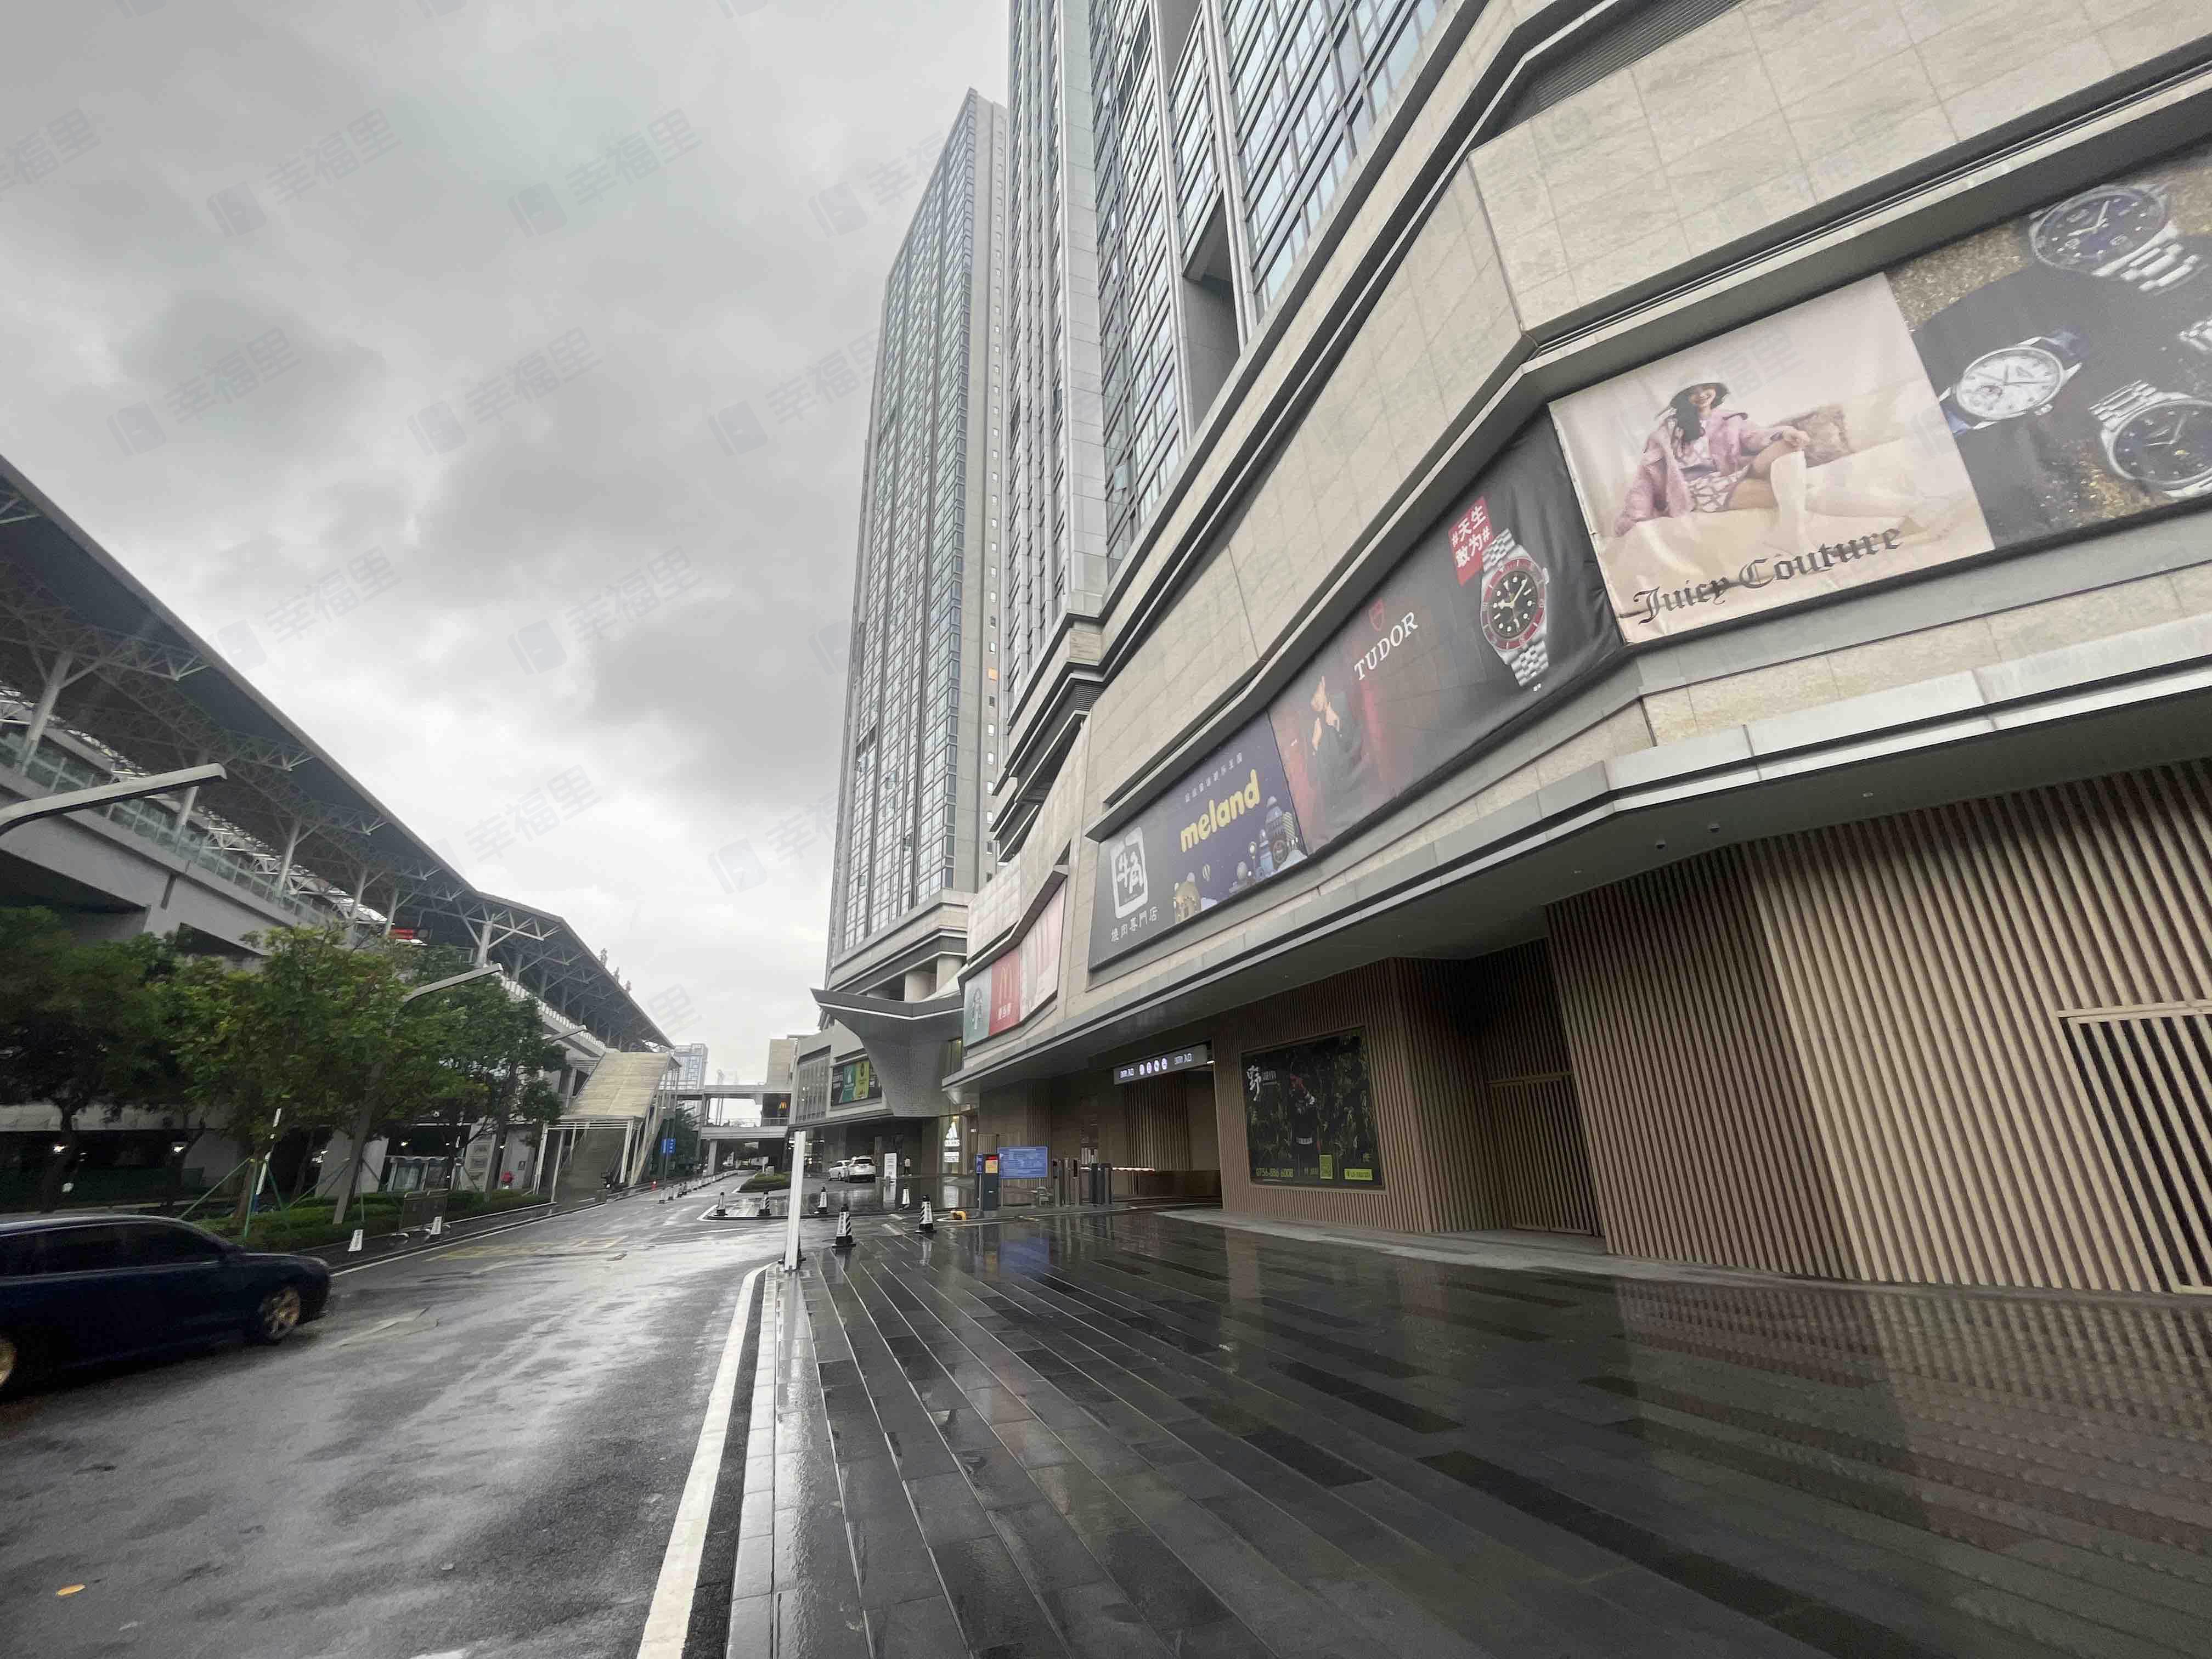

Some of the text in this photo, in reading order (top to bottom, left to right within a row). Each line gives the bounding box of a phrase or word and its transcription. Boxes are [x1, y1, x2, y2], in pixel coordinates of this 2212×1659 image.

[1451, 505, 1487, 548] #天生
[1455, 526, 1491, 568] 敢为#
[1633, 527, 1904, 625] Juicy Couture
[1353, 612, 1418, 681] TUDOR
[1180, 769, 1260, 853] meland
[1117, 851, 1144, 894] 牛角
